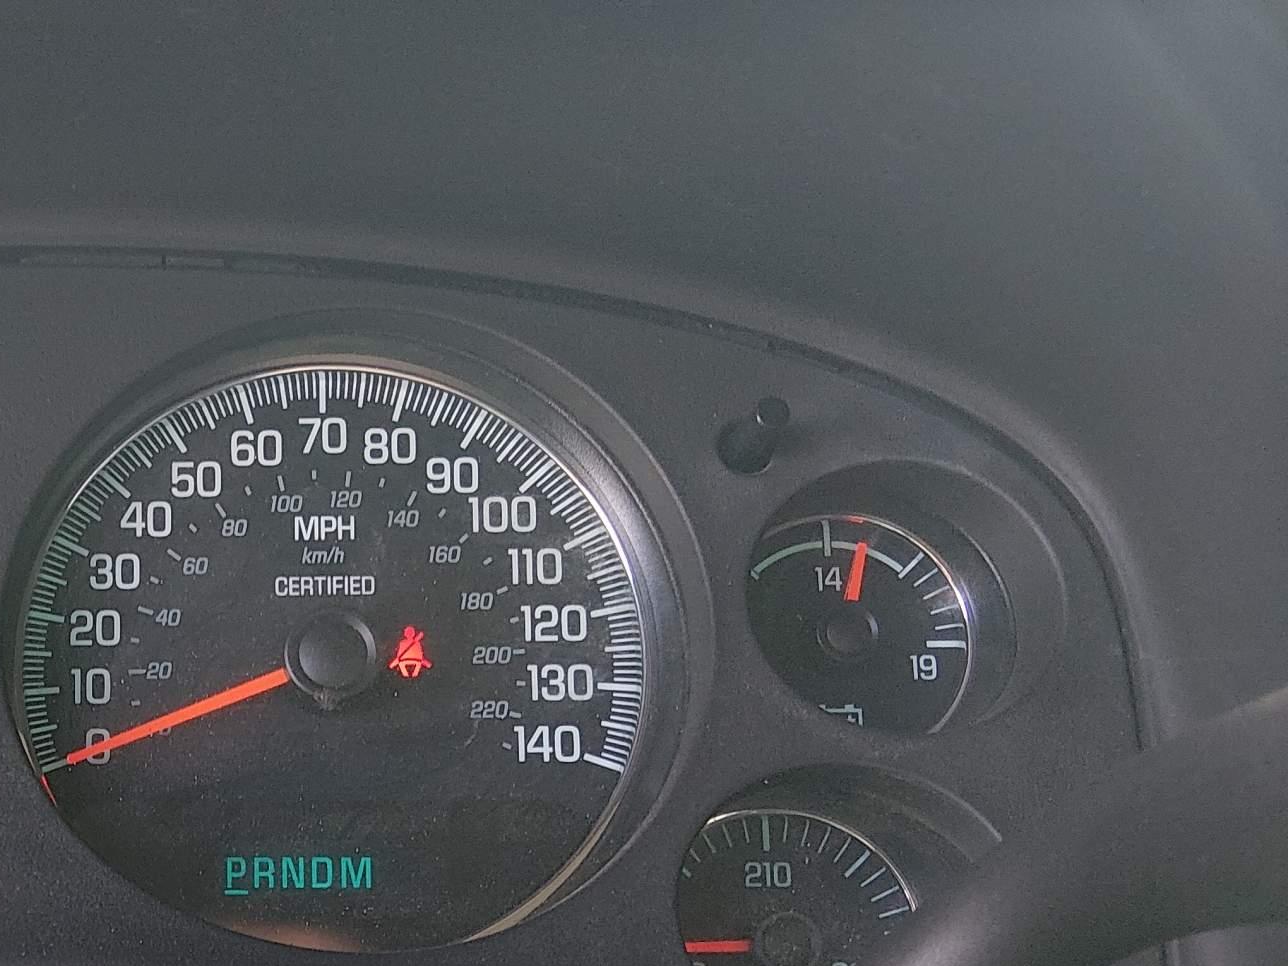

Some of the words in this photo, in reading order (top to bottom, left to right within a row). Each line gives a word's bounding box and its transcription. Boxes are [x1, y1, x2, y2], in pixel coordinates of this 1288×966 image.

[231, 430, 282, 466] 60
[298, 417, 347, 454] 70
[364, 428, 416, 464] 80
[171, 461, 222, 498] 50
[426, 457, 479, 494] 90
[270, 494, 302, 513] 100
[330, 490, 362, 509] 120
[120, 501, 172, 538] 40
[221, 518, 248, 537] 80
[294, 515, 355, 541] MPH
[387, 510, 419, 529] 140
[469, 497, 537, 534] 100
[182, 557, 209, 576] 60
[301, 546, 345, 565] km/h
[429, 545, 461, 564] 160
[508, 548, 563, 585] 110
[89, 554, 140, 591] 30
[814, 566, 843, 592] 14
[275, 575, 376, 597] CERTIFIED
[460, 592, 493, 611] 180
[70, 610, 121, 647] 20
[155, 609, 181, 627] 40
[521, 605, 587, 642] 120
[472, 647, 511, 665] 200
[910, 655, 938, 681] 19
[145, 662, 172, 680] 20
[527, 664, 593, 701] 130
[70, 668, 111, 705] 10
[470, 701, 508, 719] 220
[86, 728, 111, 764] 0
[513, 726, 581, 763] 140
[226, 856, 372, 889] PRNDM
[744, 862, 792, 888] 210
